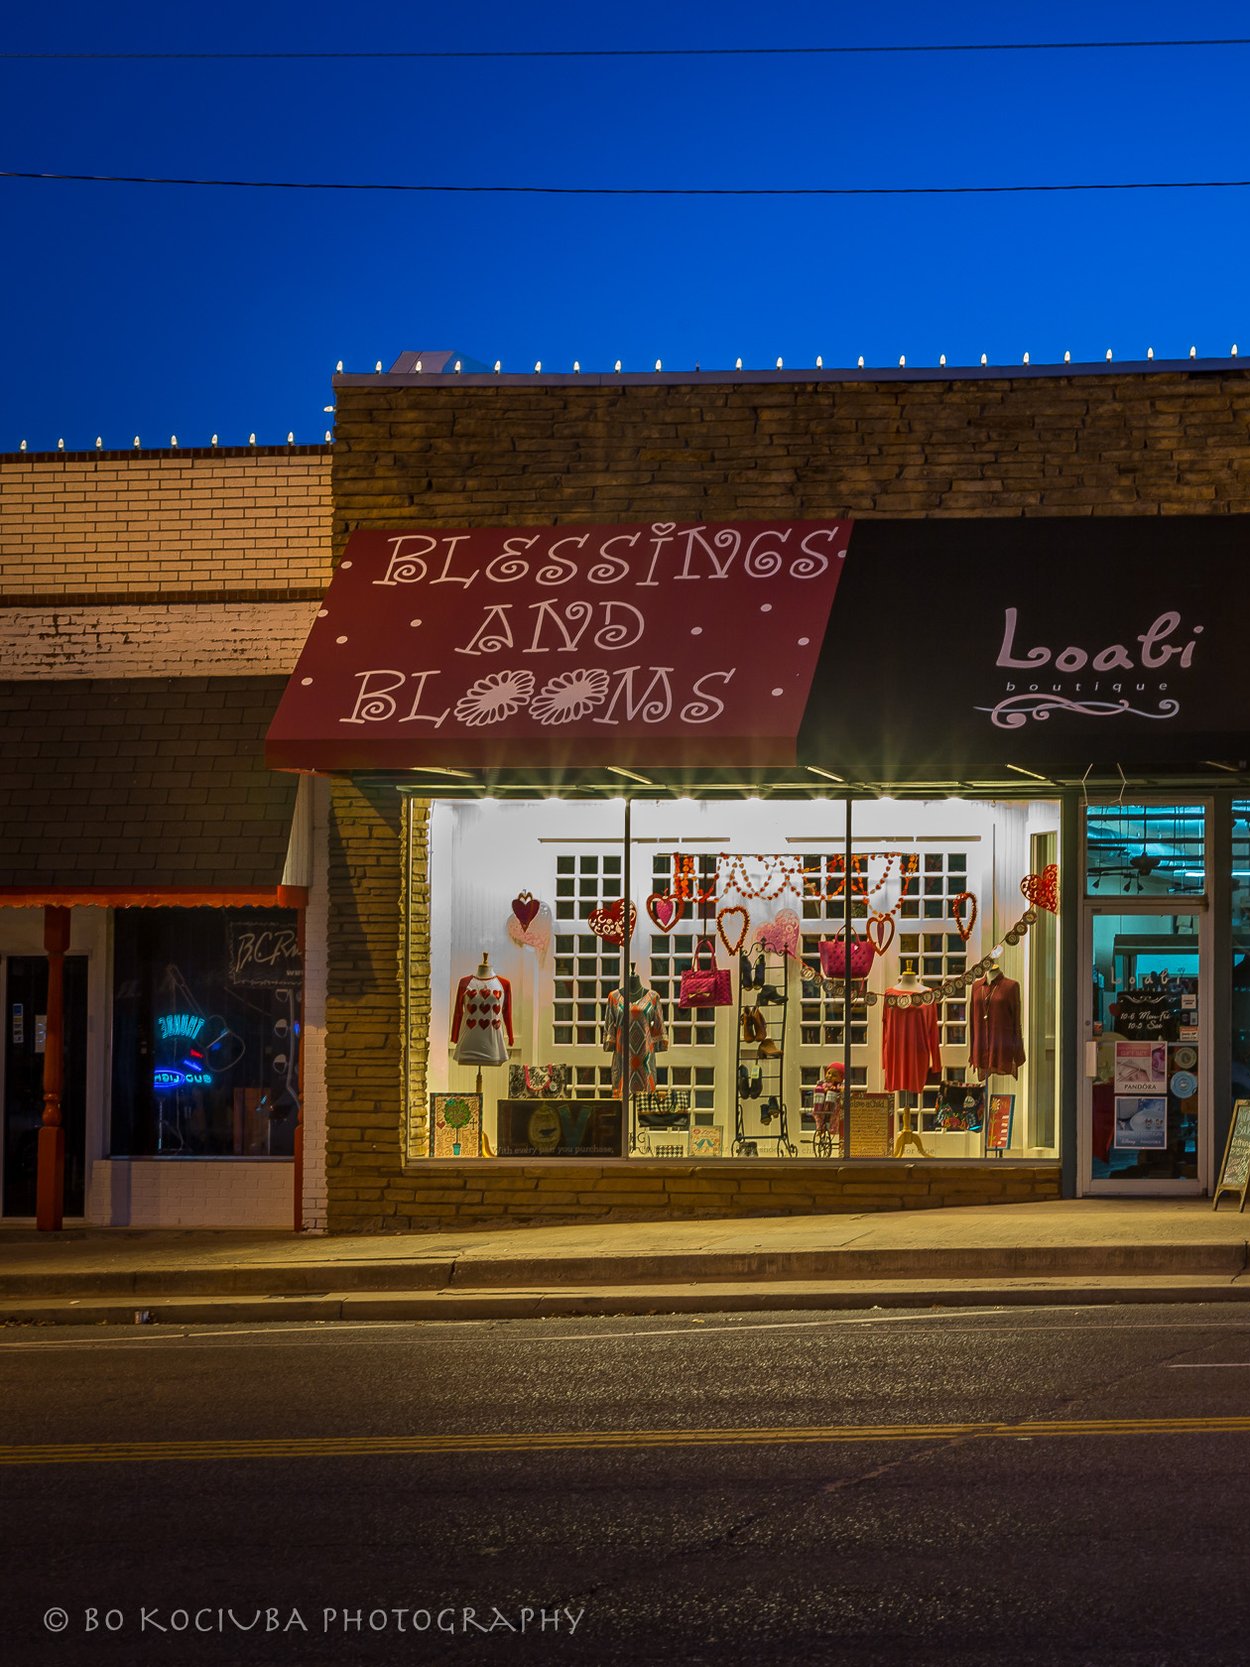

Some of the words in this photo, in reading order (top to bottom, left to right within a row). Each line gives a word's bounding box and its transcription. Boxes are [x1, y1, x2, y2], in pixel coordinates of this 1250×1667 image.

[372, 522, 838, 588] BLESSINGS
[454, 598, 644, 655] AND
[995, 607, 1204, 673] Loabi
[1006, 681, 1168, 693] boutique
